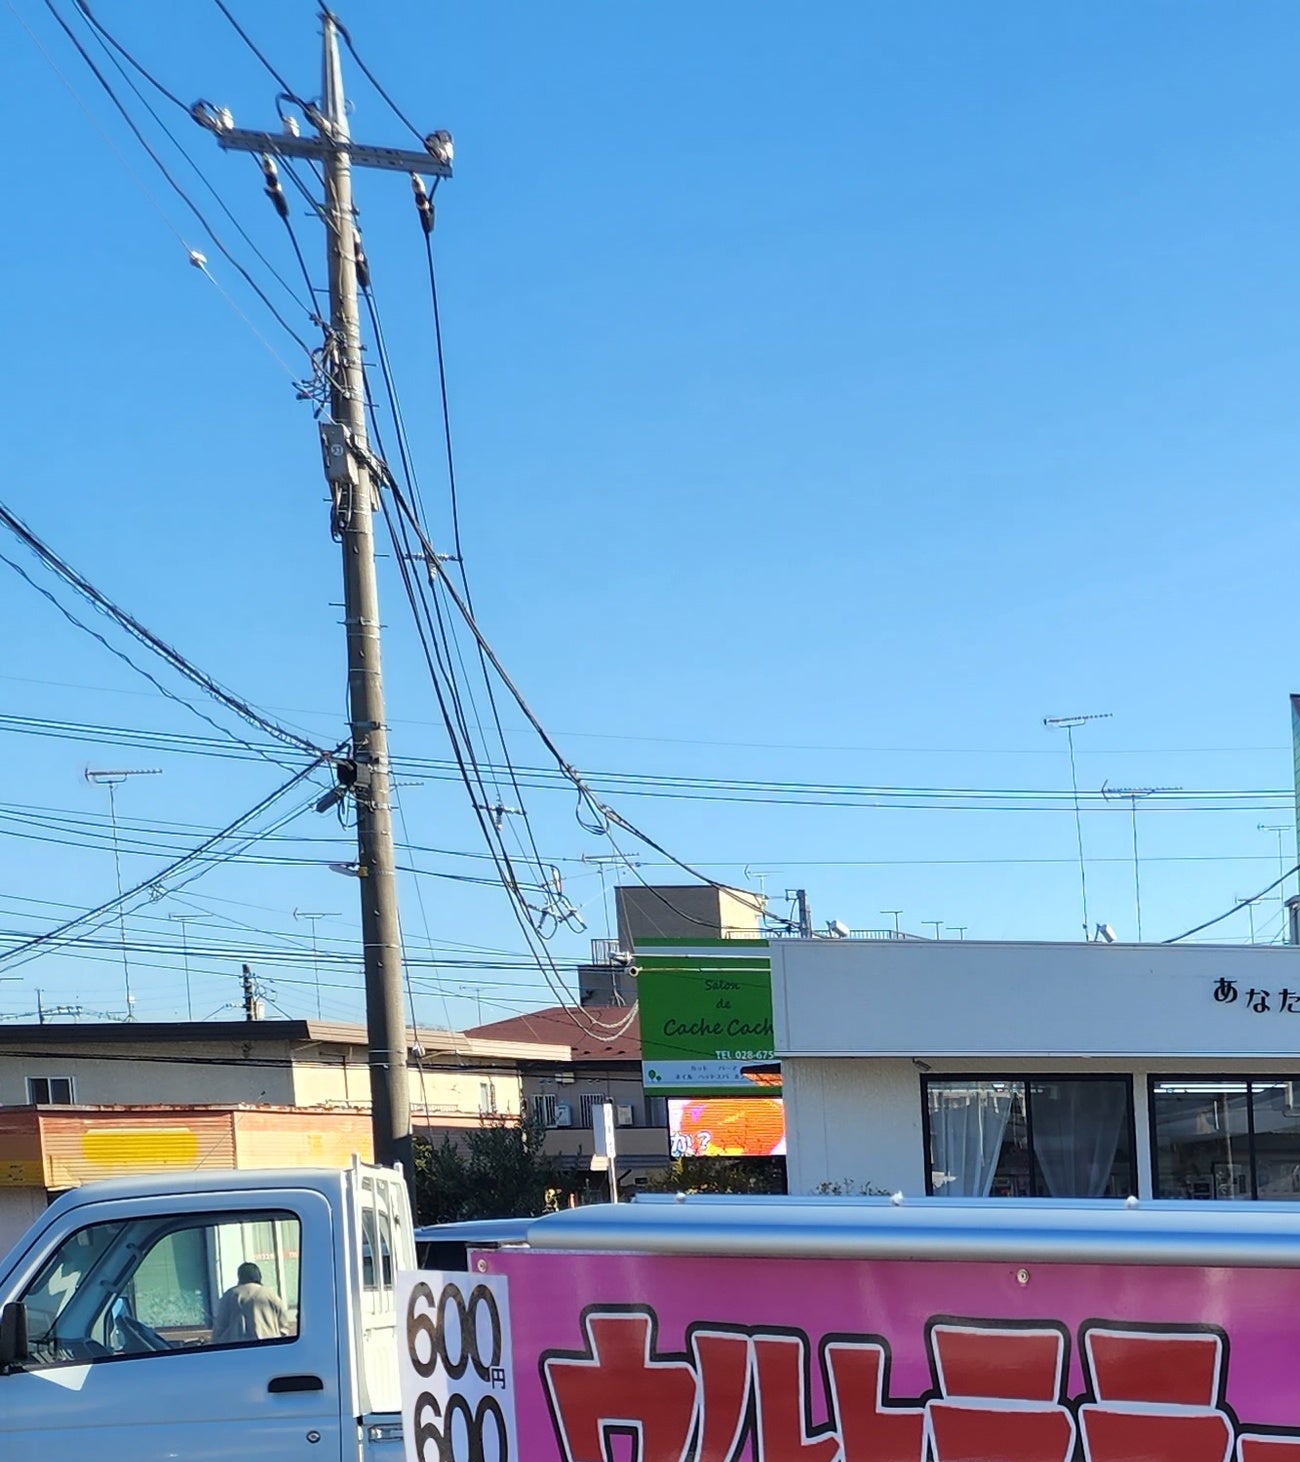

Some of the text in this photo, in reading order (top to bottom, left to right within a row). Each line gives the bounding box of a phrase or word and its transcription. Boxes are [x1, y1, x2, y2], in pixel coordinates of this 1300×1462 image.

[705, 979, 741, 991] Salon
[716, 998, 731, 1009] de
[663, 1018, 724, 1037] Cache
[715, 1050, 734, 1060] TEL
[407, 1280, 507, 1391] 600円
